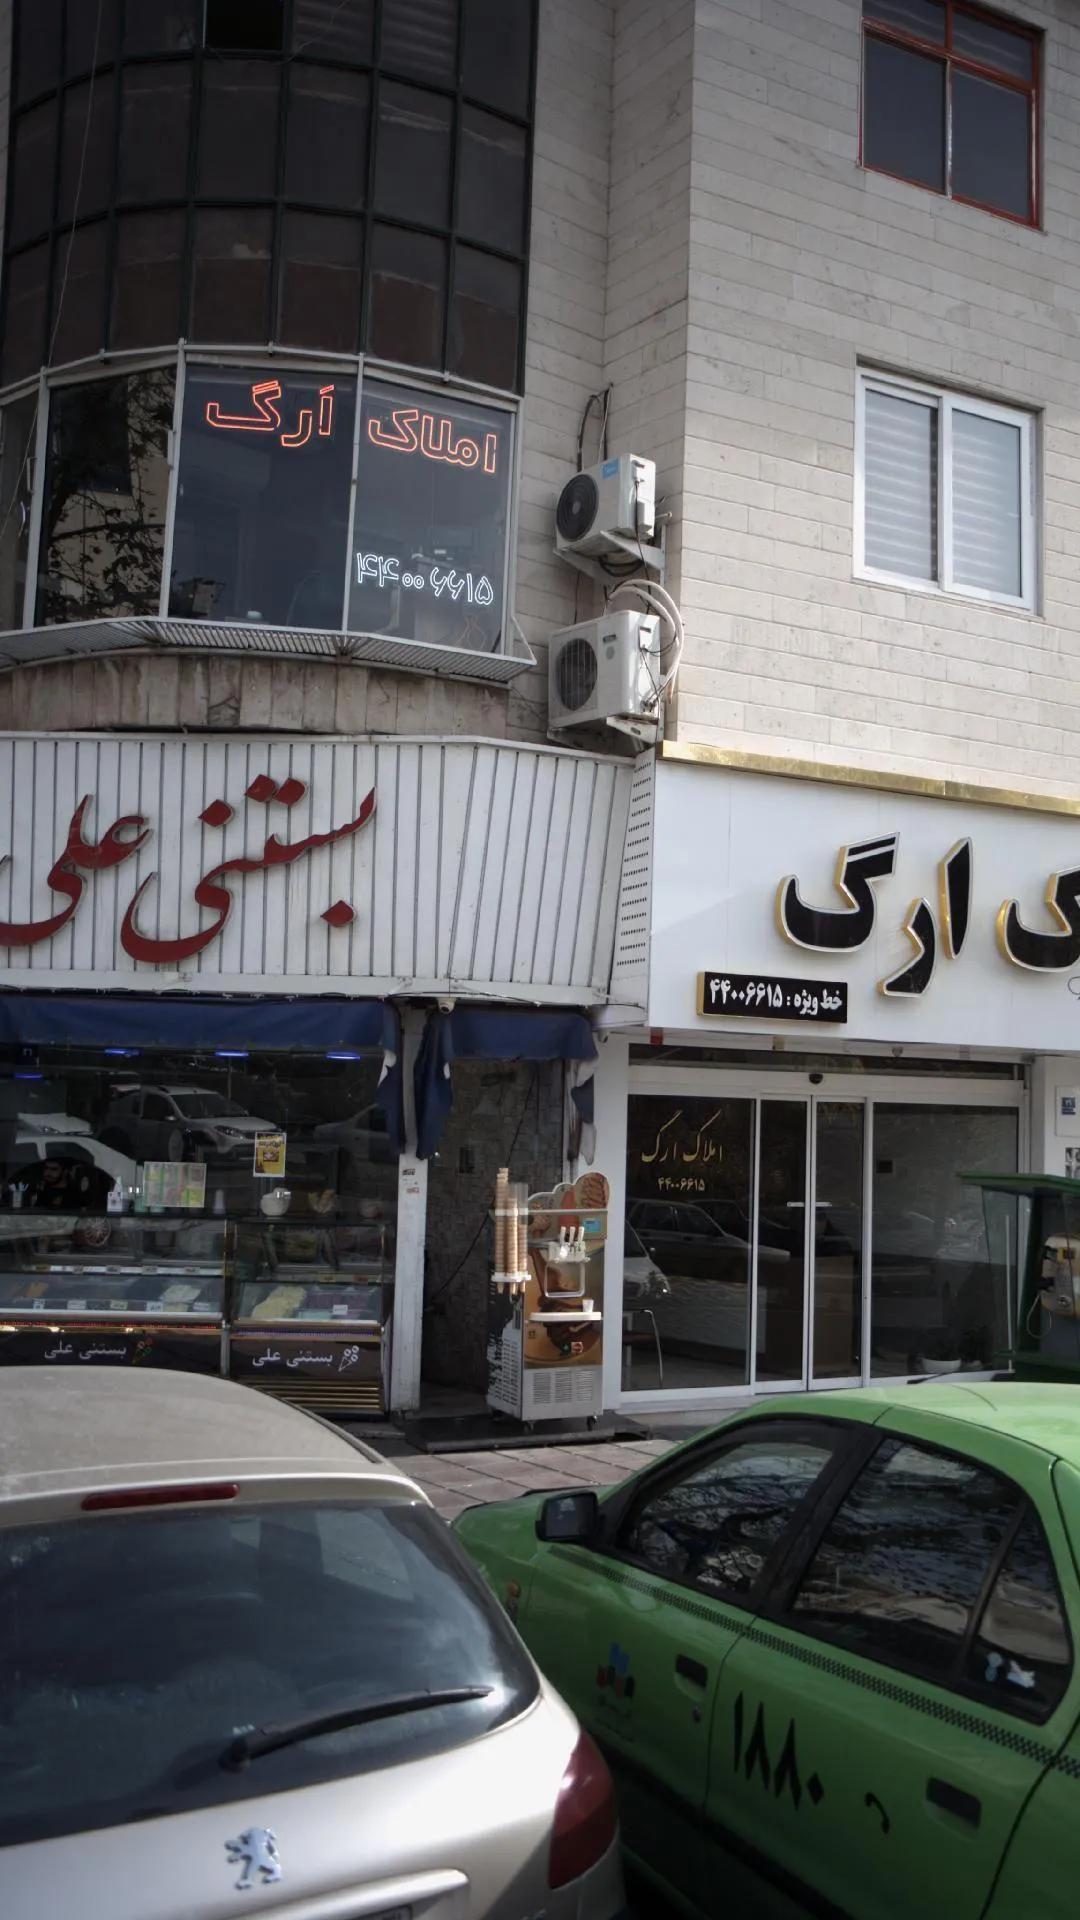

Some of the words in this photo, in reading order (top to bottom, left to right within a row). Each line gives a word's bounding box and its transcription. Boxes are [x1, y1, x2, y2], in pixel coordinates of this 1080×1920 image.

[368, 409, 498, 474] املاک
[357, 552, 494, 605] ۴۴۰۰۶۶۱۵
[0, 794, 153, 947] علی
[121, 774, 377, 963] بستنی
[775, 832, 973, 997] ارگ
[710, 978, 783, 1008] ۴۴۰۰۶۶۱۵
[820, 988, 843, 1010] خط
[641, 1109, 683, 1162] ارگ
[683, 1109, 723, 1162] املاک
[657, 1177, 705, 1192] ۴۴۰۰۶۶۱۵
[44, 1340, 73, 1360] علی
[79, 1345, 127, 1361] بستنی
[252, 1346, 281, 1367] علی
[286, 1350, 333, 1368] بستنی
[734, 1690, 825, 1812] ۱۸۸۰
